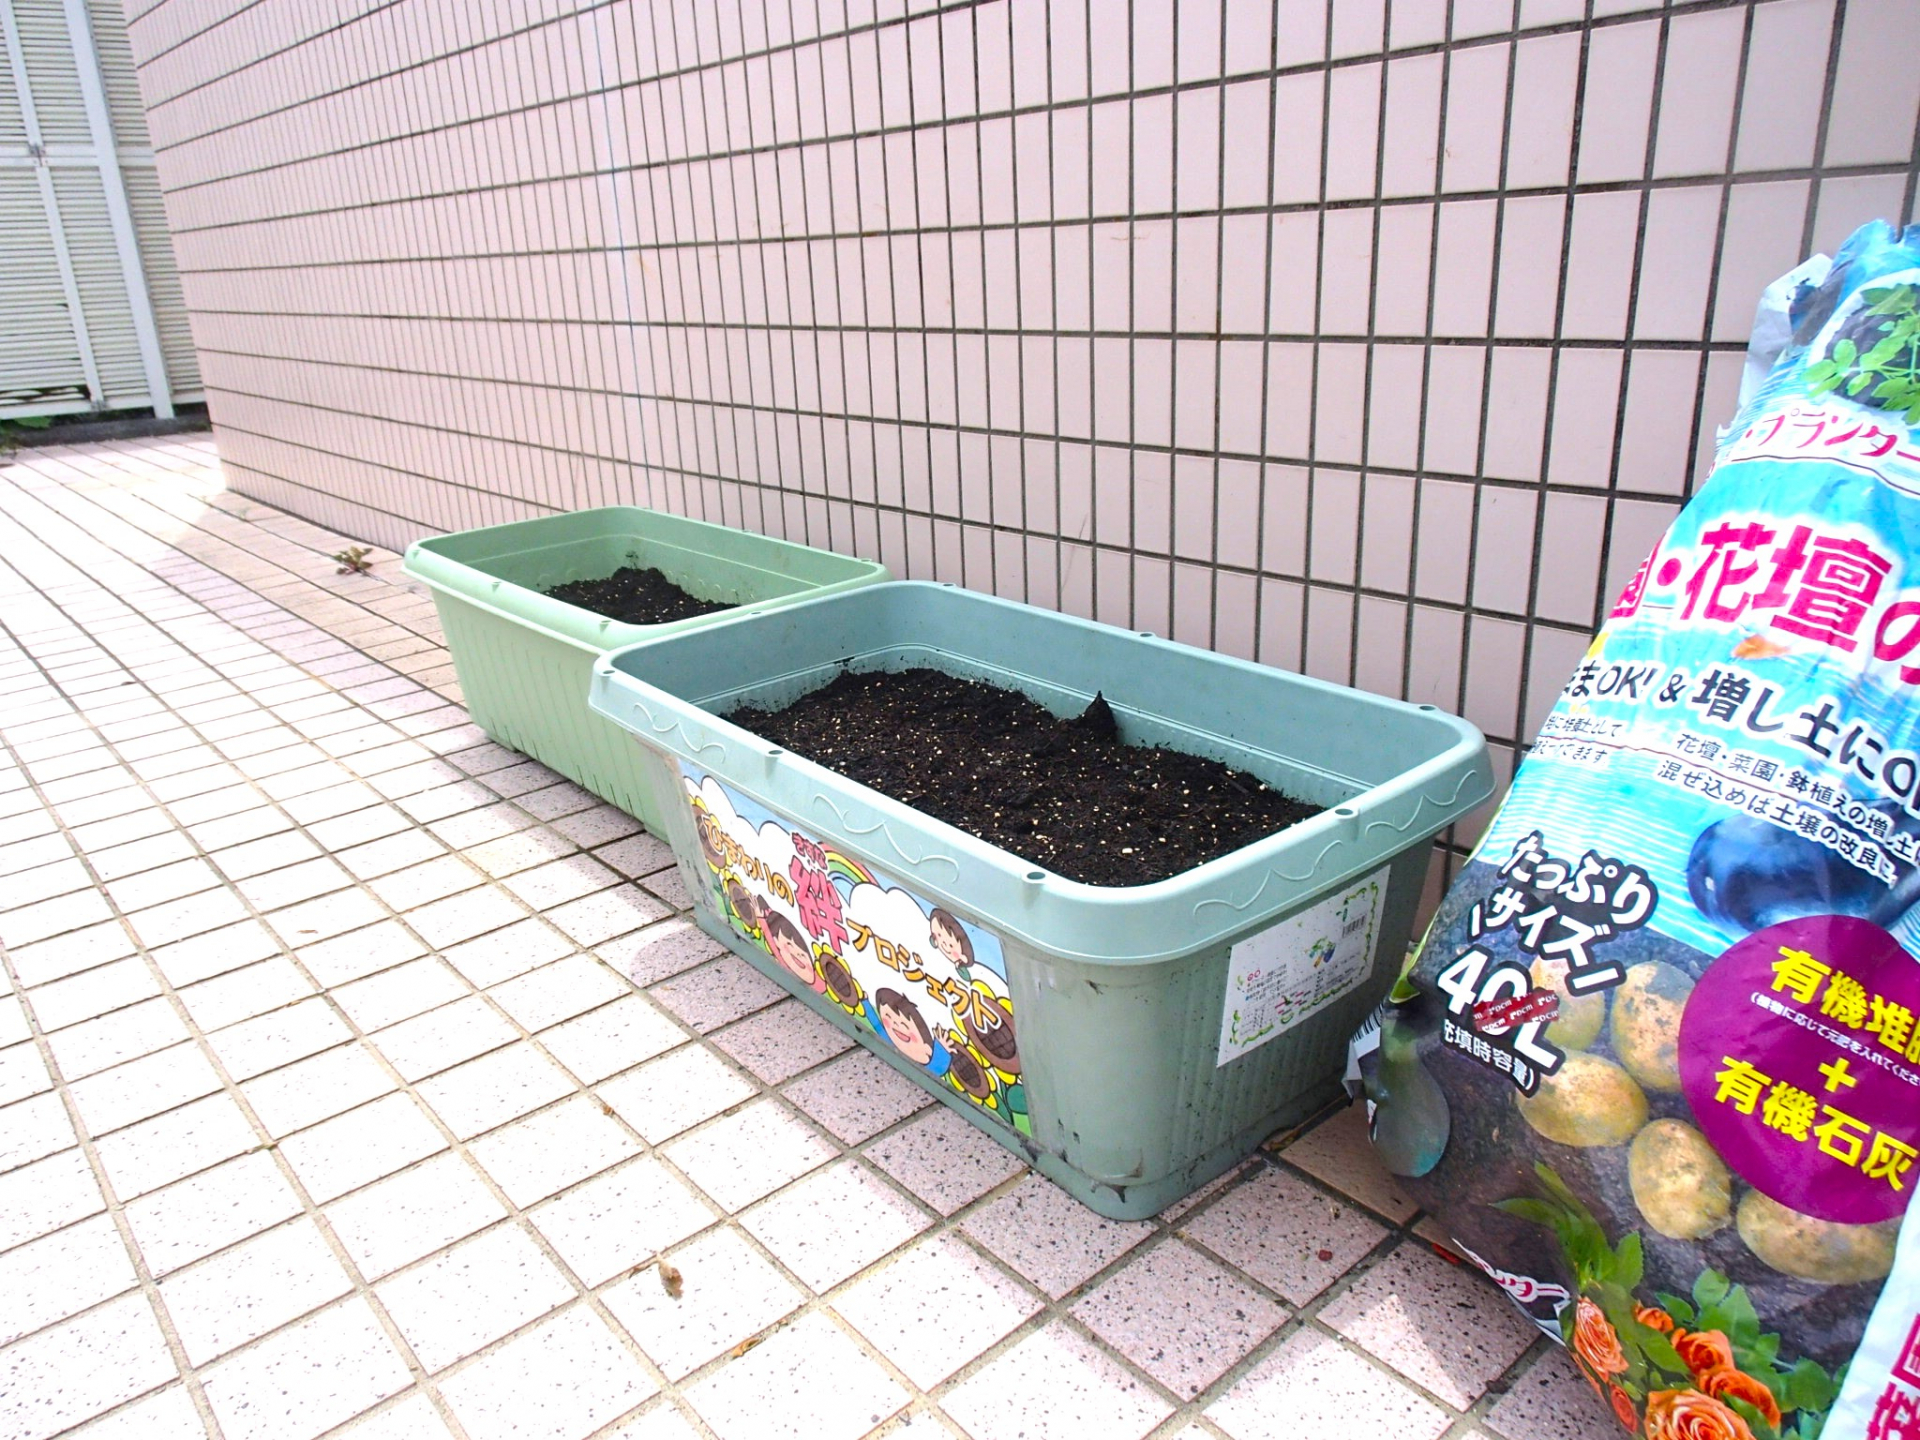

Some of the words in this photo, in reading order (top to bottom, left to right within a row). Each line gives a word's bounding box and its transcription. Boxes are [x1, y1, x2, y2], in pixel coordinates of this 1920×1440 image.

[1659, 673, 1686, 703] &
[1691, 669, 1920, 812] 増し土にO
[1501, 835, 1651, 925] たっぷり
[1714, 1055, 1918, 1192] 有機石灰
